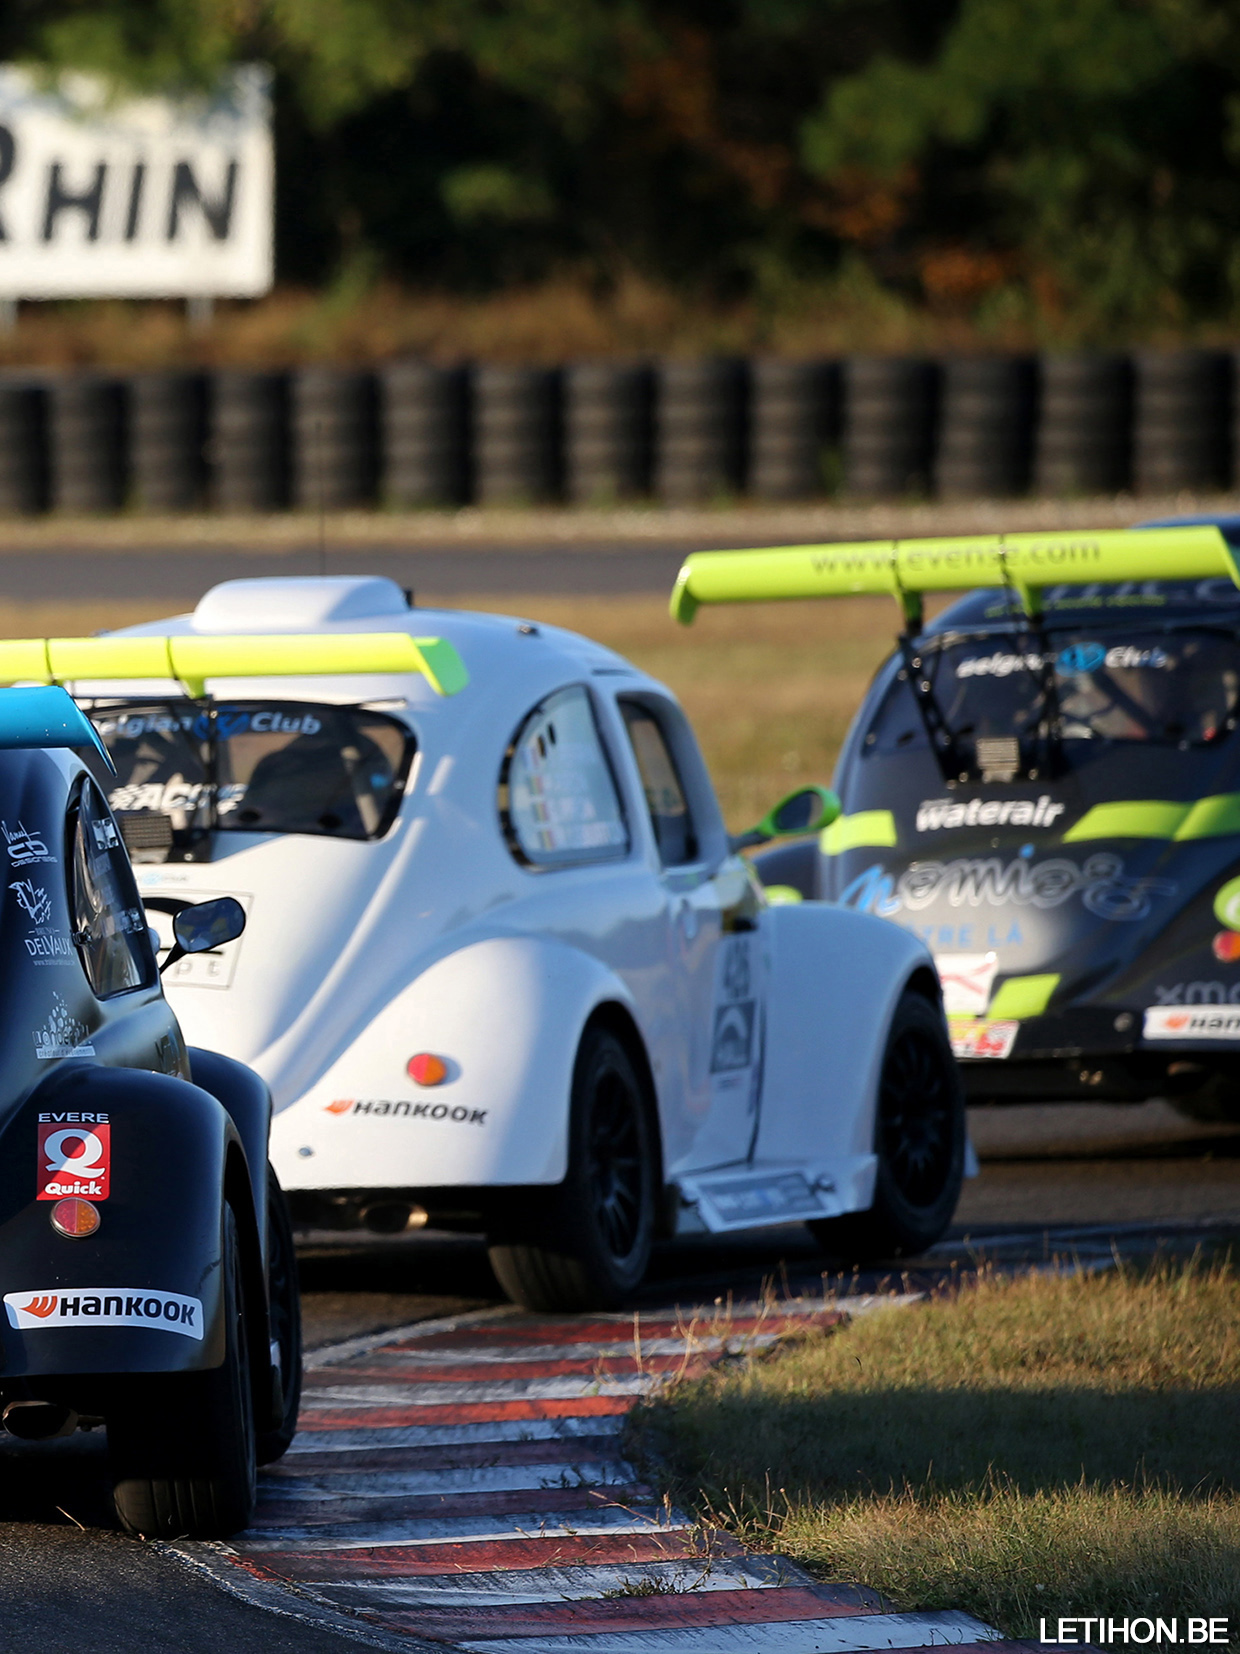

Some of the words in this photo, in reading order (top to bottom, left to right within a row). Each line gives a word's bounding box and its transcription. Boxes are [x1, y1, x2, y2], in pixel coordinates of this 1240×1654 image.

[249, 710, 323, 736] Club
[23, 935, 73, 957] DELVAUX
[38, 1112, 110, 1124] EVERE
[44, 1180, 103, 1196] Quick
